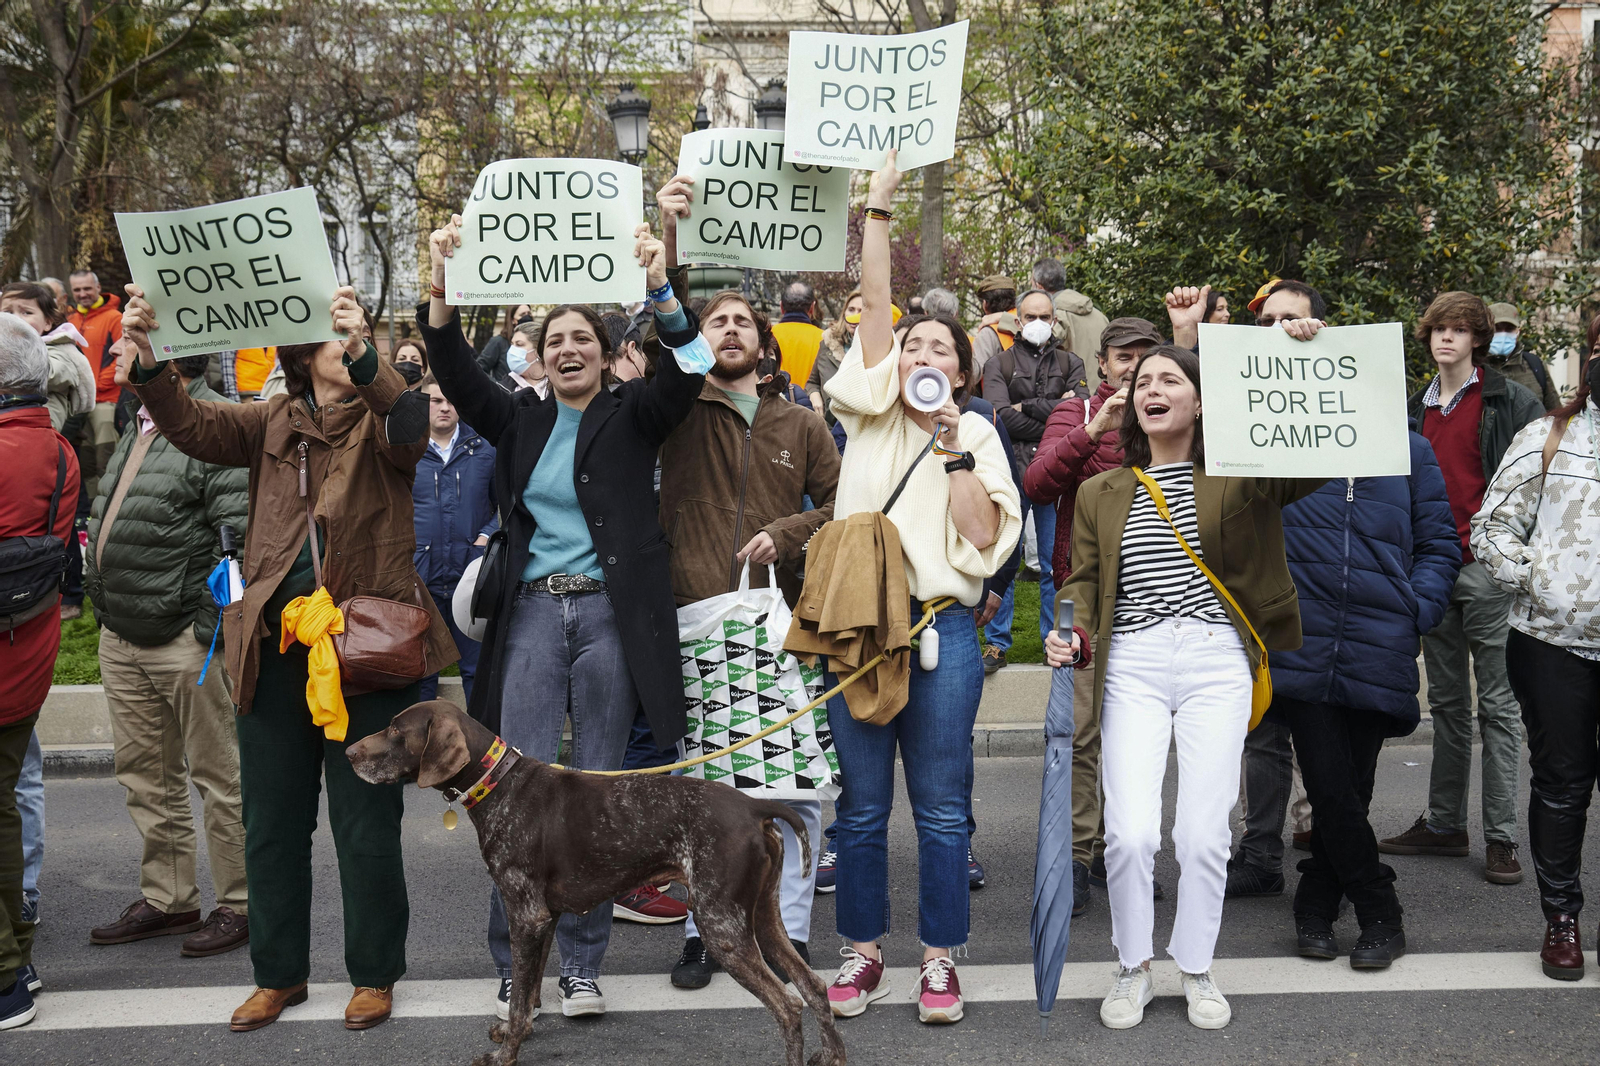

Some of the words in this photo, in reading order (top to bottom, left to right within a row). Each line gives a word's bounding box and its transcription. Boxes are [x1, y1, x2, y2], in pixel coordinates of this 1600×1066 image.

[814, 39, 947, 74] JUNTOS
[820, 81, 896, 113] POR
[907, 80, 938, 111] EL
[817, 118, 934, 152] CAMPO
[801, 152, 860, 163] @thenatureofpablo
[473, 170, 619, 202] JUNTOS
[703, 177, 779, 211] POR
[790, 184, 826, 213] EL
[143, 206, 293, 257] JUNTOS
[478, 212, 559, 243] POR
[571, 211, 615, 241] EL
[699, 217, 823, 252] CAMPO
[157, 261, 245, 298] POR
[248, 254, 302, 288] EL
[478, 252, 615, 284] CAMPO
[463, 291, 524, 300] @thenatureofpablo
[176, 294, 312, 337] CAMPO
[171, 339, 231, 353] @thenatureofpablo
[1240, 355, 1358, 381] JUNTOS
[1247, 389, 1309, 414] POR
[1318, 391, 1356, 415] EL
[1249, 423, 1358, 449] CAMPO
